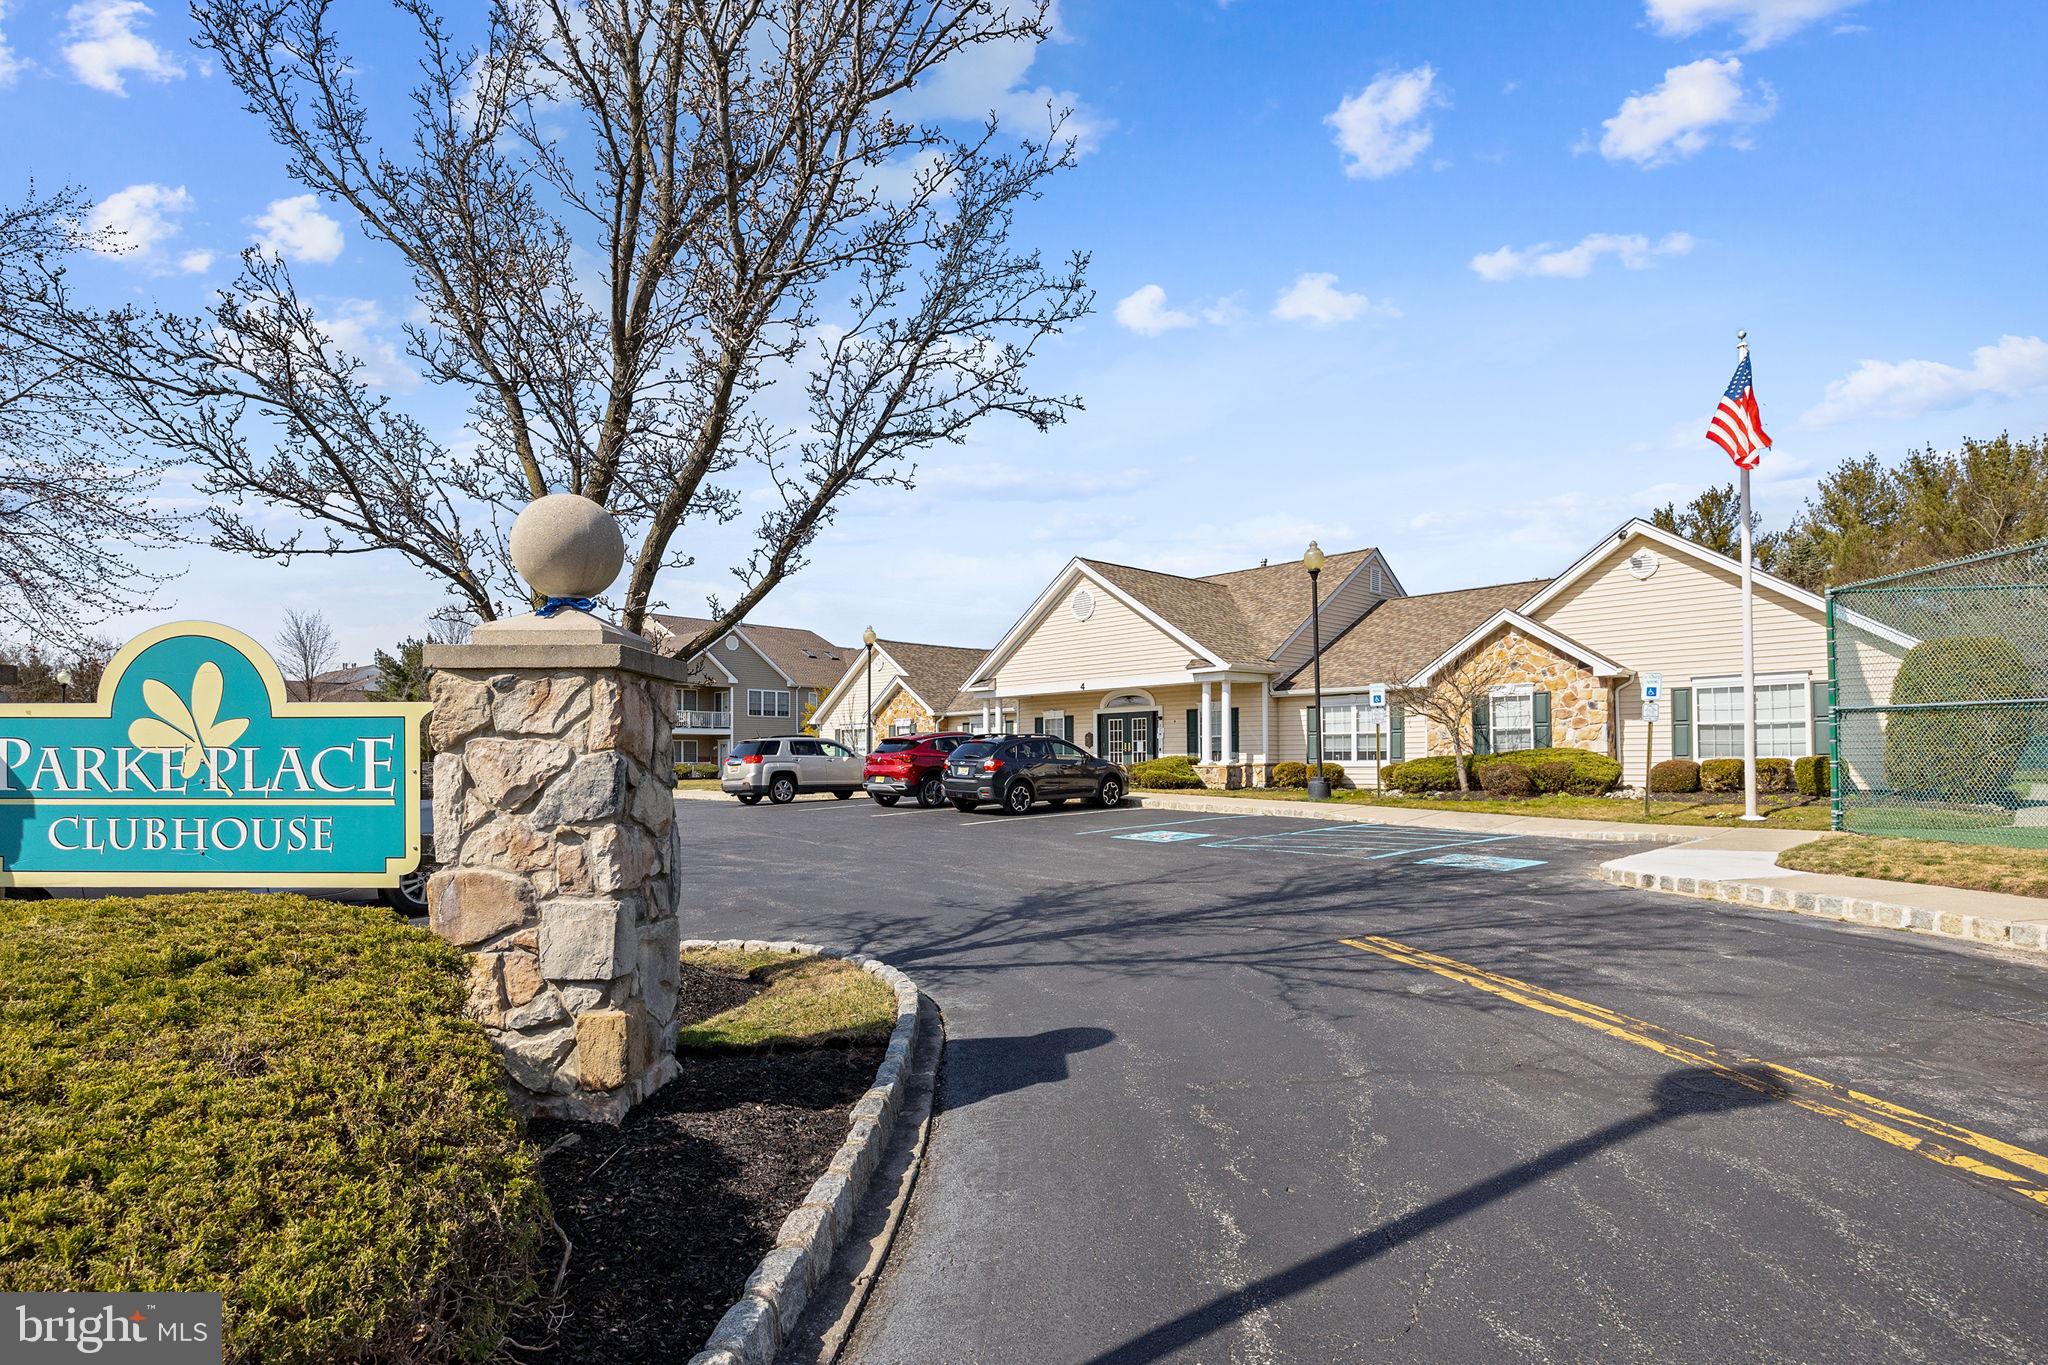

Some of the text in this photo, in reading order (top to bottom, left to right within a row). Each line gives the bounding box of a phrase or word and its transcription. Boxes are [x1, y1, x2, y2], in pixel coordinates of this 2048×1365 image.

[0, 734, 396, 798] PARKE PLACE
[48, 815, 334, 854] CLUBHOUSE
